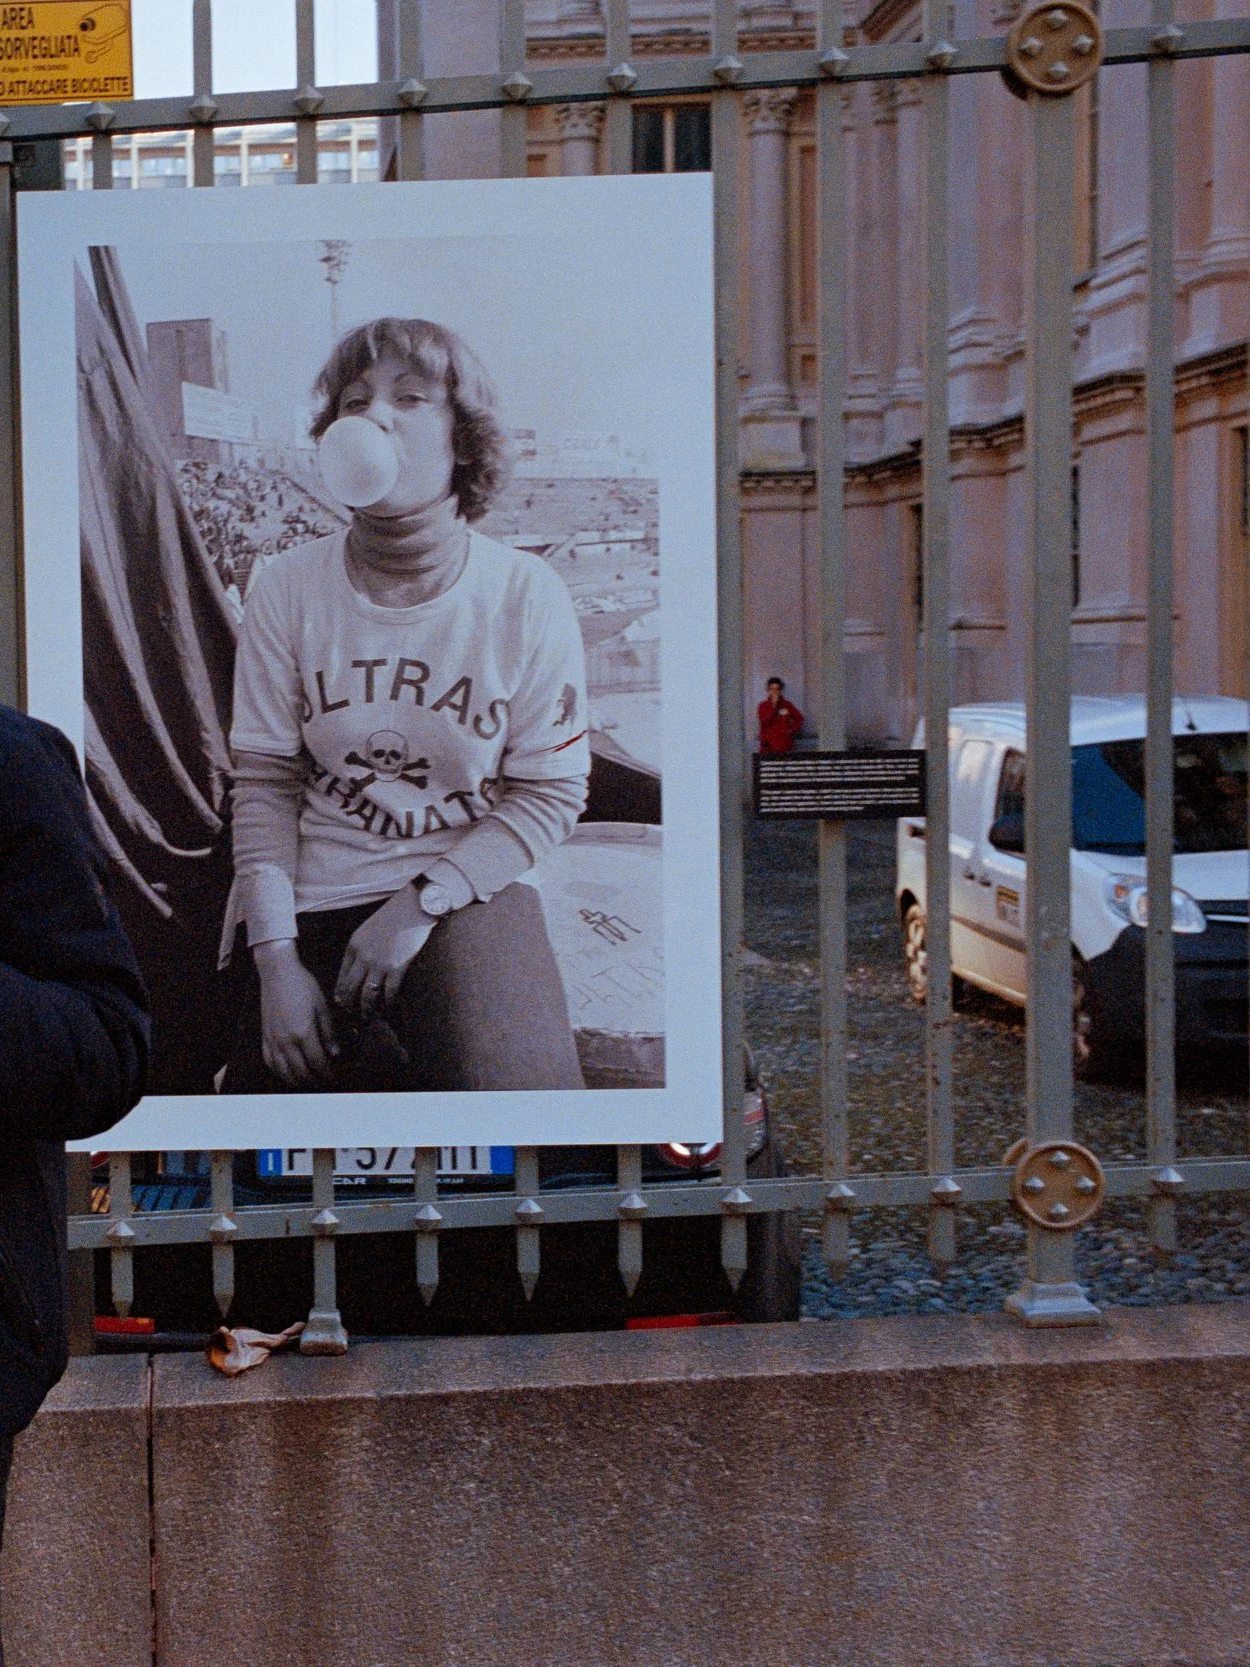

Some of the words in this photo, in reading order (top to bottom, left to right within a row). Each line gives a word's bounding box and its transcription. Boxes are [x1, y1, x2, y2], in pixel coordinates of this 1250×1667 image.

[0, 7, 35, 31] AREA
[8, 78, 69, 96] ATTACCARE
[72, 76, 129, 93] BICICLETTE
